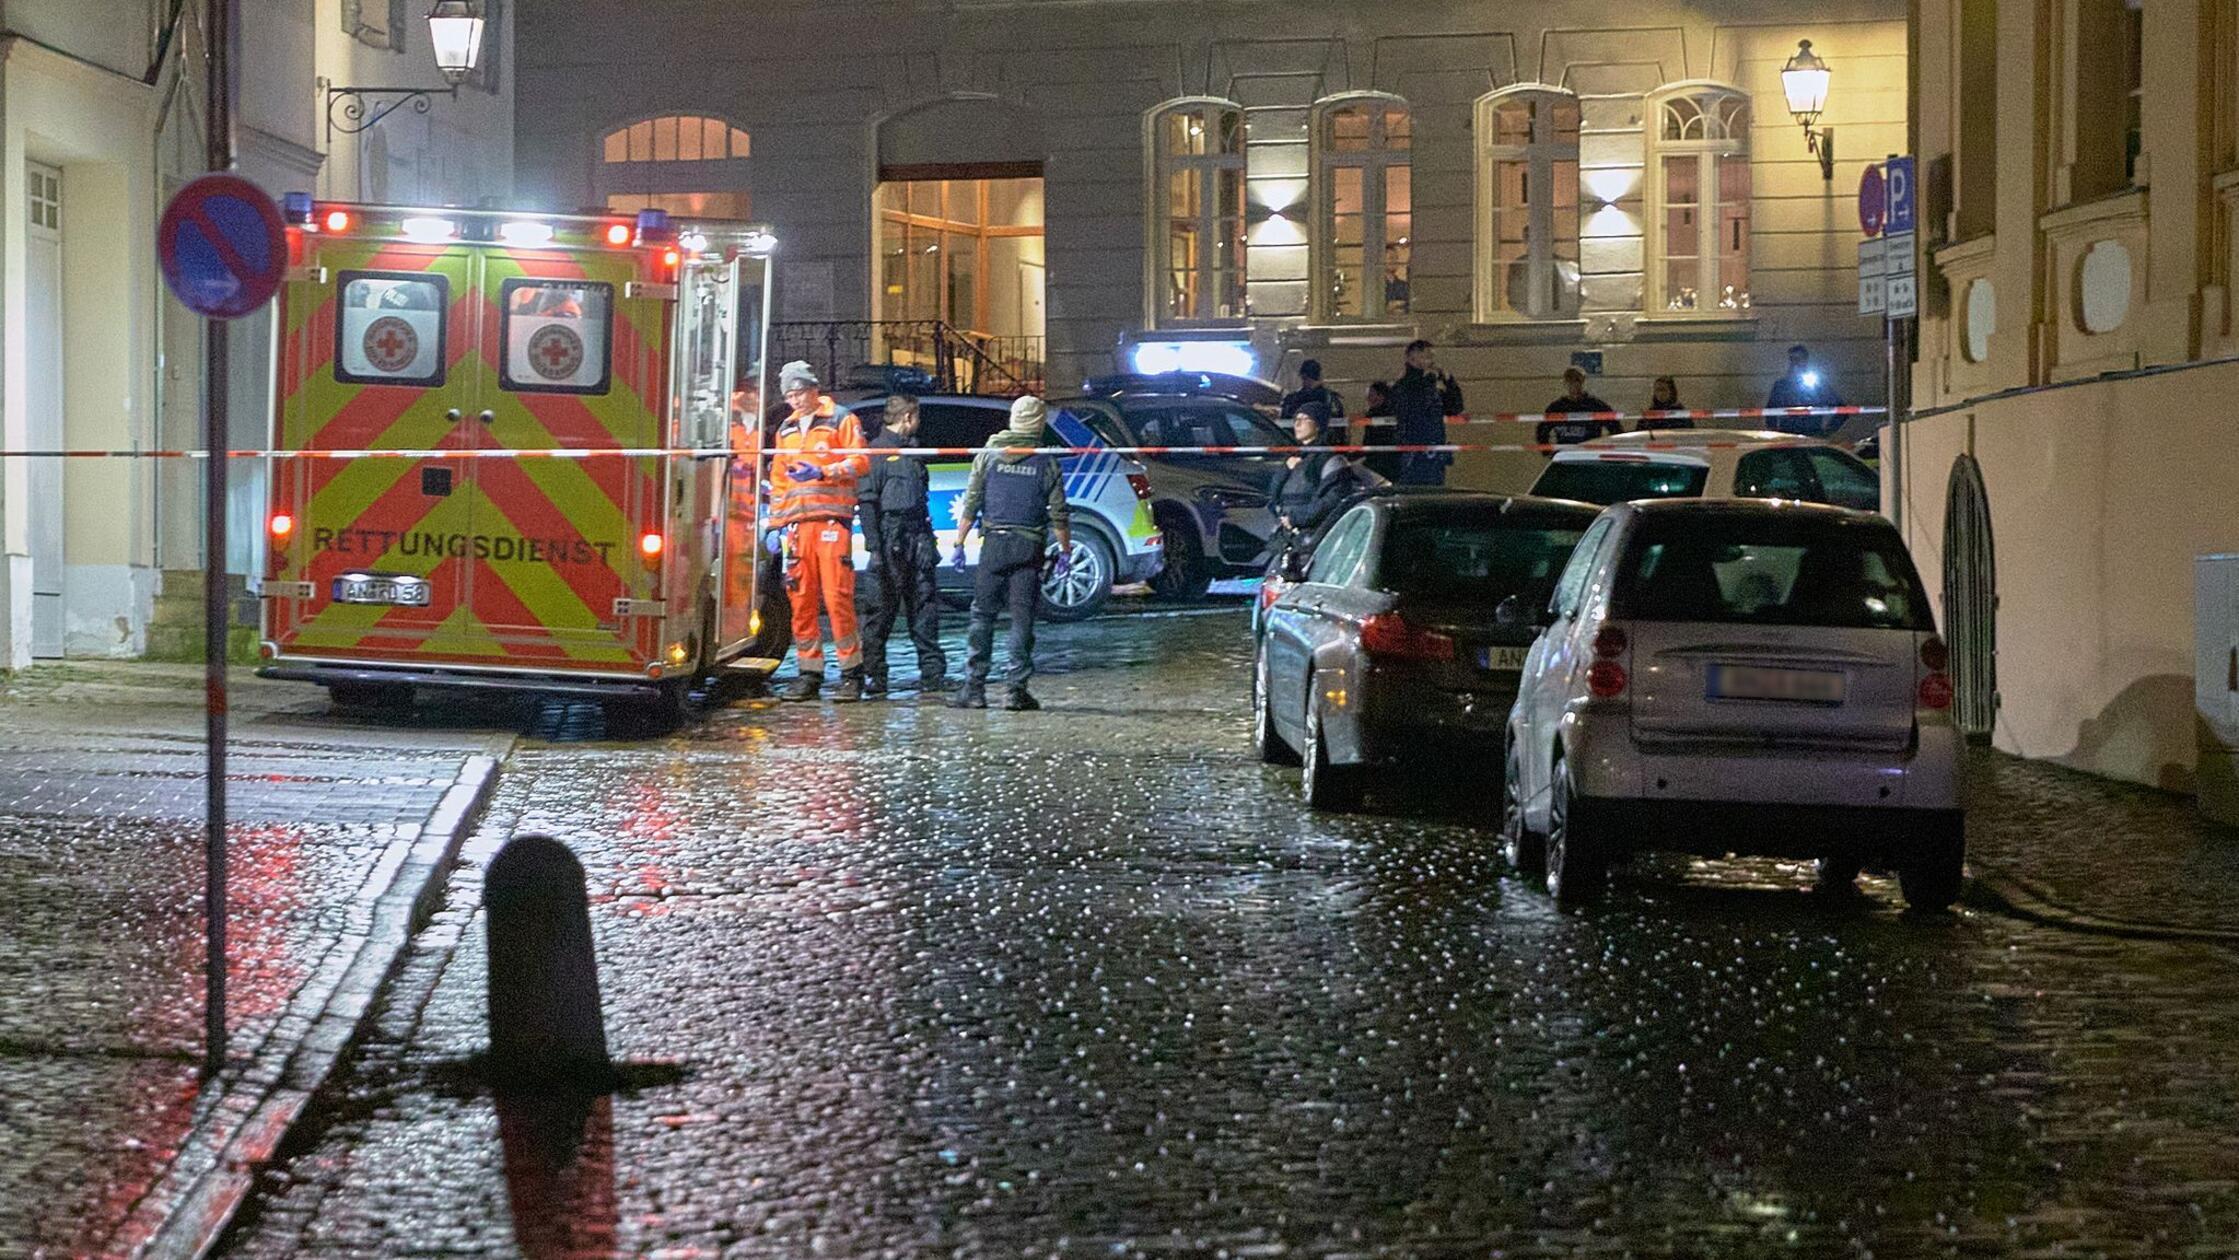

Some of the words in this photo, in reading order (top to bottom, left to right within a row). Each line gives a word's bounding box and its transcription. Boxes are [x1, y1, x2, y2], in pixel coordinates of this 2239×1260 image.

[1890, 168, 1906, 224] P
[997, 463, 1037, 476] POLIZEI
[313, 527, 616, 565] RETTUNGSDIENST
